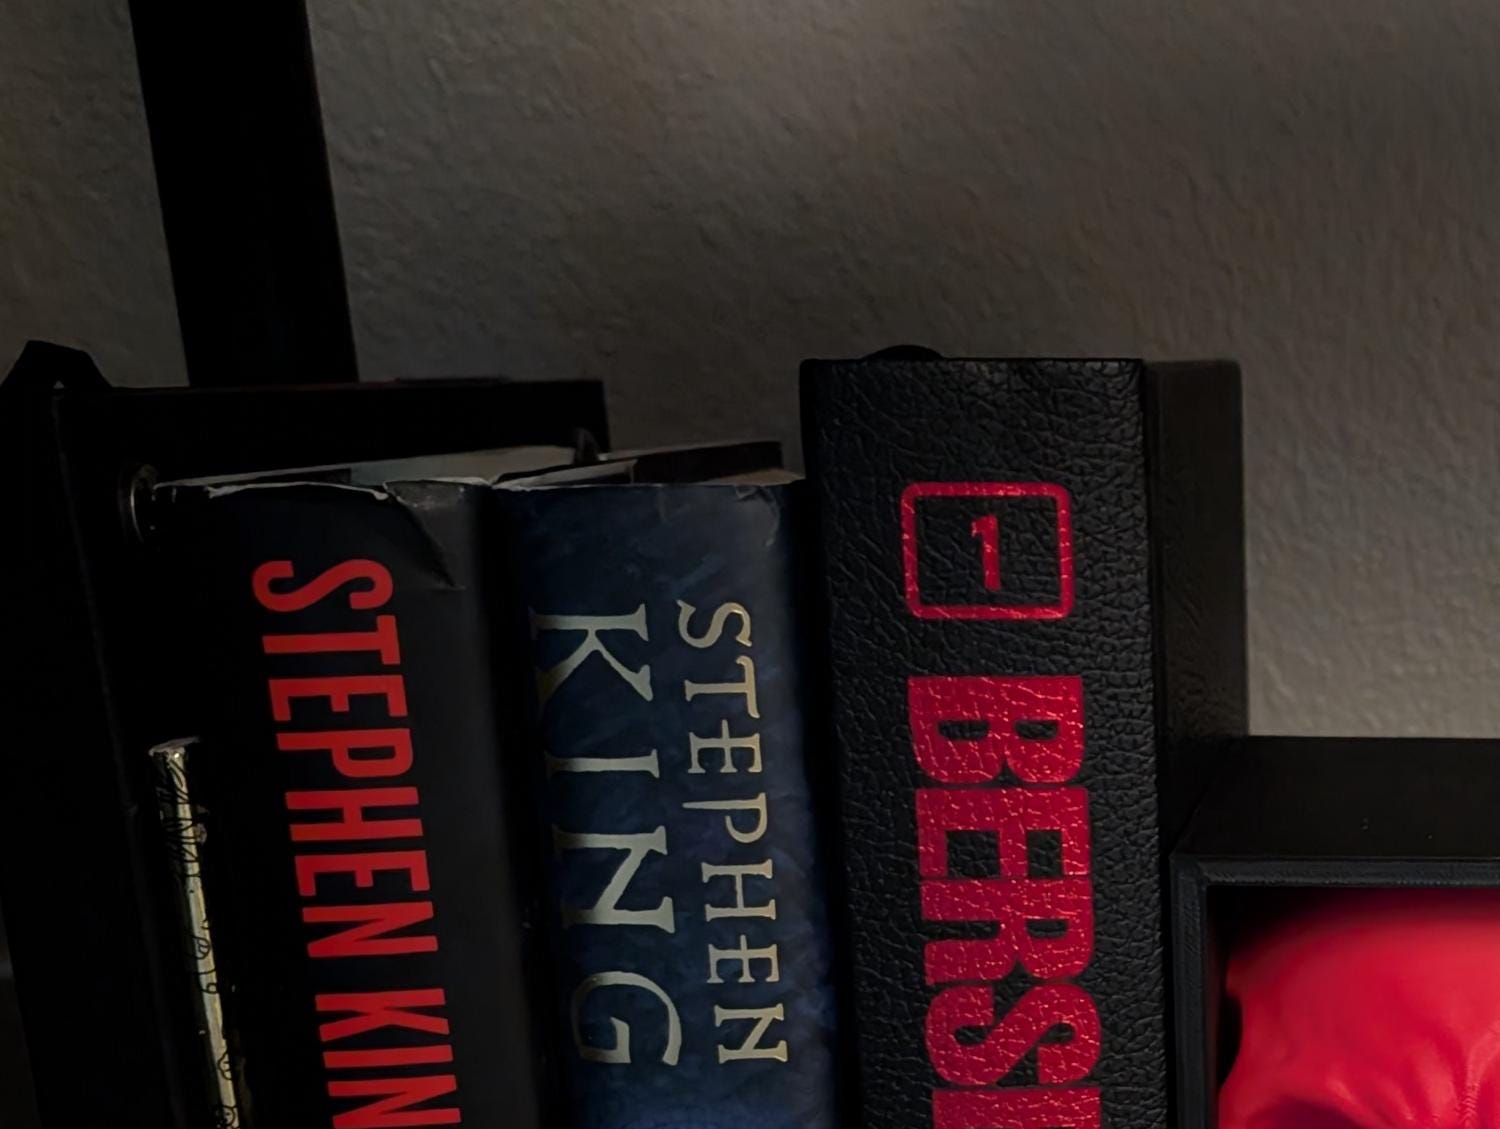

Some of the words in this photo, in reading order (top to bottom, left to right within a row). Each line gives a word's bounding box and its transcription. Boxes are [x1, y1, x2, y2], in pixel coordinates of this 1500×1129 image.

[251, 559, 438, 958] STEPHEN
[971, 515, 998, 591] 1
[528, 602, 682, 1067] KING
[677, 600, 789, 1065] STEPHEN
